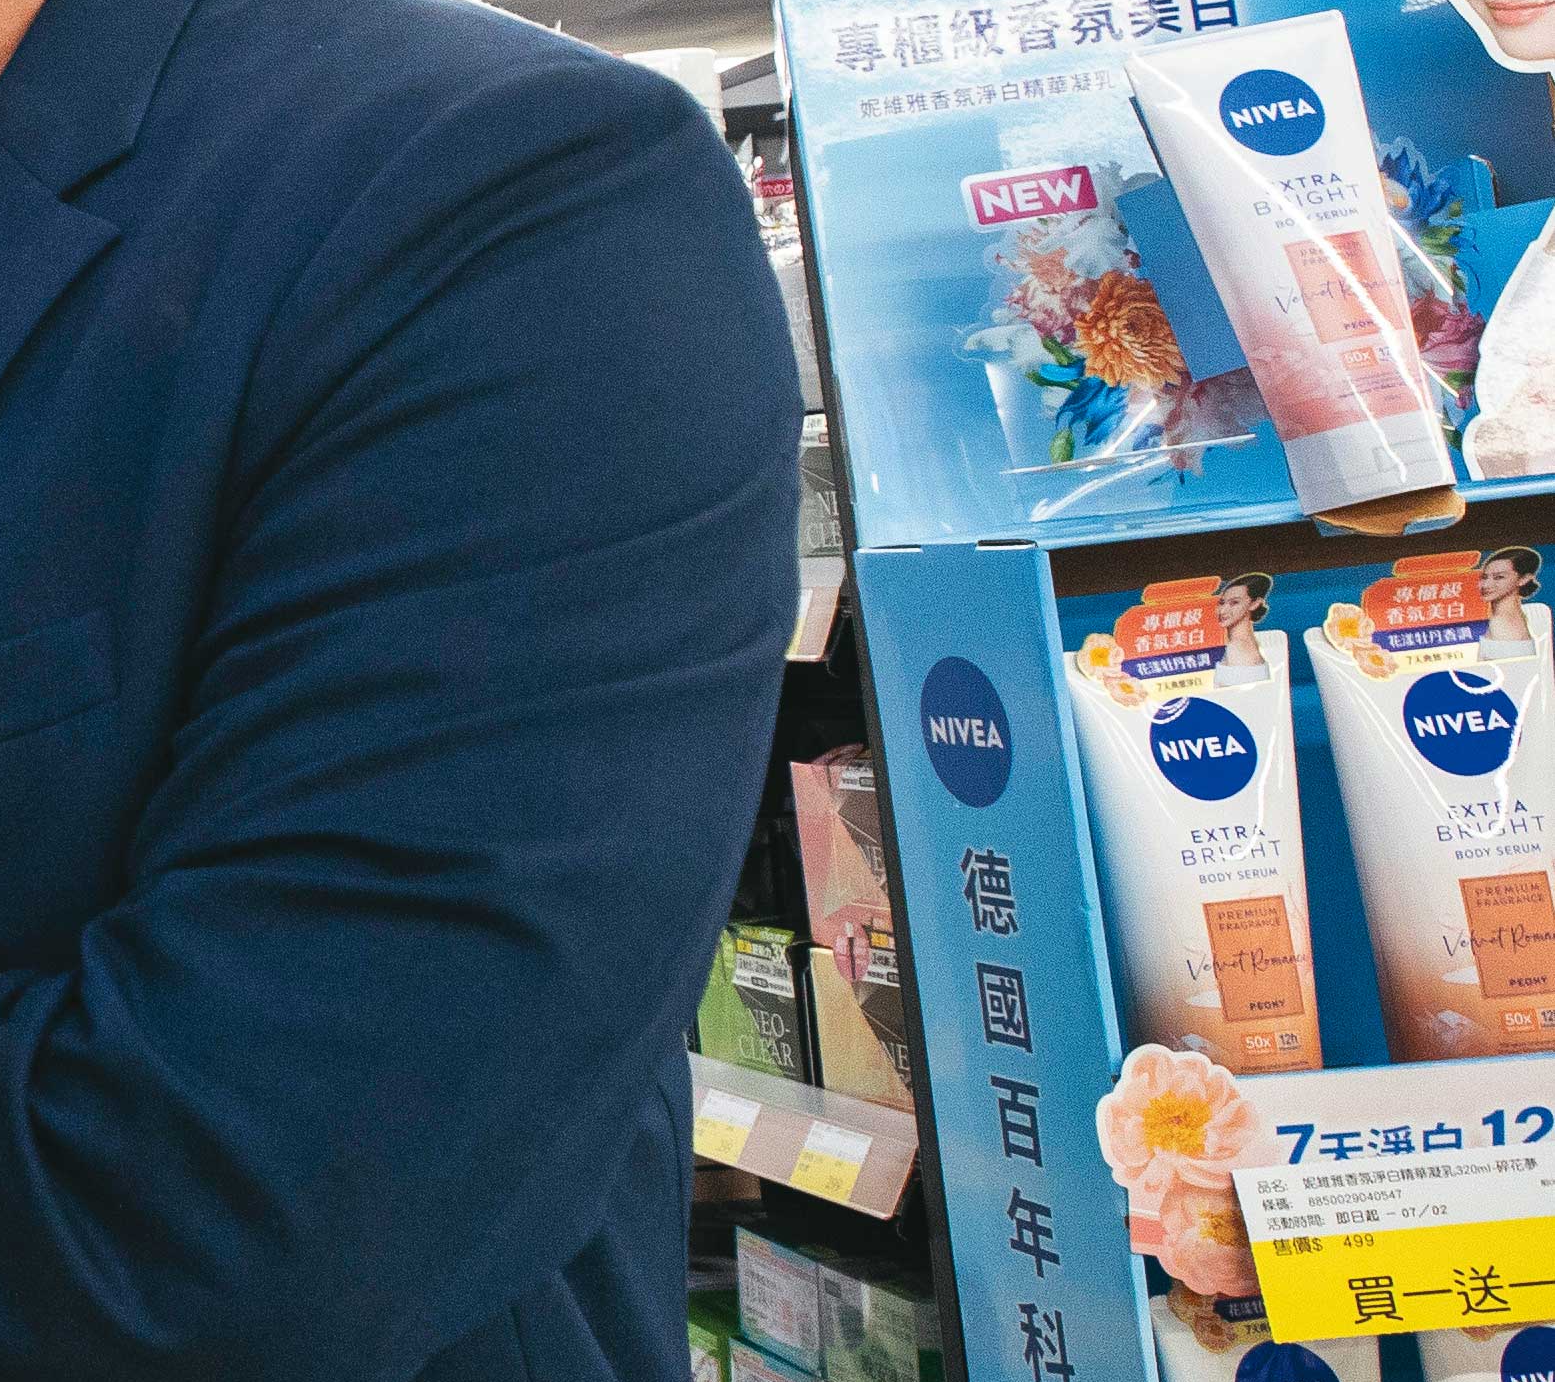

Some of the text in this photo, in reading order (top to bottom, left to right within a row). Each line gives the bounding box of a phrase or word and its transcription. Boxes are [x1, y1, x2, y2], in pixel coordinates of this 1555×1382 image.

[860, 70, 1117, 121] 妮維雅香氛淨白精華凝乳
[1229, 98, 1318, 129] NIVEA
[979, 175, 1084, 218] NEW
[1385, 601, 1466, 624] 香氛美白
[1135, 628, 1205, 650] 香氛美白
[928, 716, 1004, 750] NIVEA
[1414, 708, 1510, 739] NIVEA
[1159, 735, 1248, 763] NIVEA
[1446, 799, 1529, 820] EXTRA
[1191, 824, 1265, 844] EXTRA
[1436, 814, 1546, 843] BRIGHT
[1454, 843, 1542, 861] BODY SERUM
[1198, 867, 1279, 885] BODY SERUM
[747, 1006, 791, 1038] NEO-
[737, 1036, 795, 1068] CLEAR
[1343, 1233, 1375, 1248] 499
[1347, 1264, 1555, 1325] 買一送一
